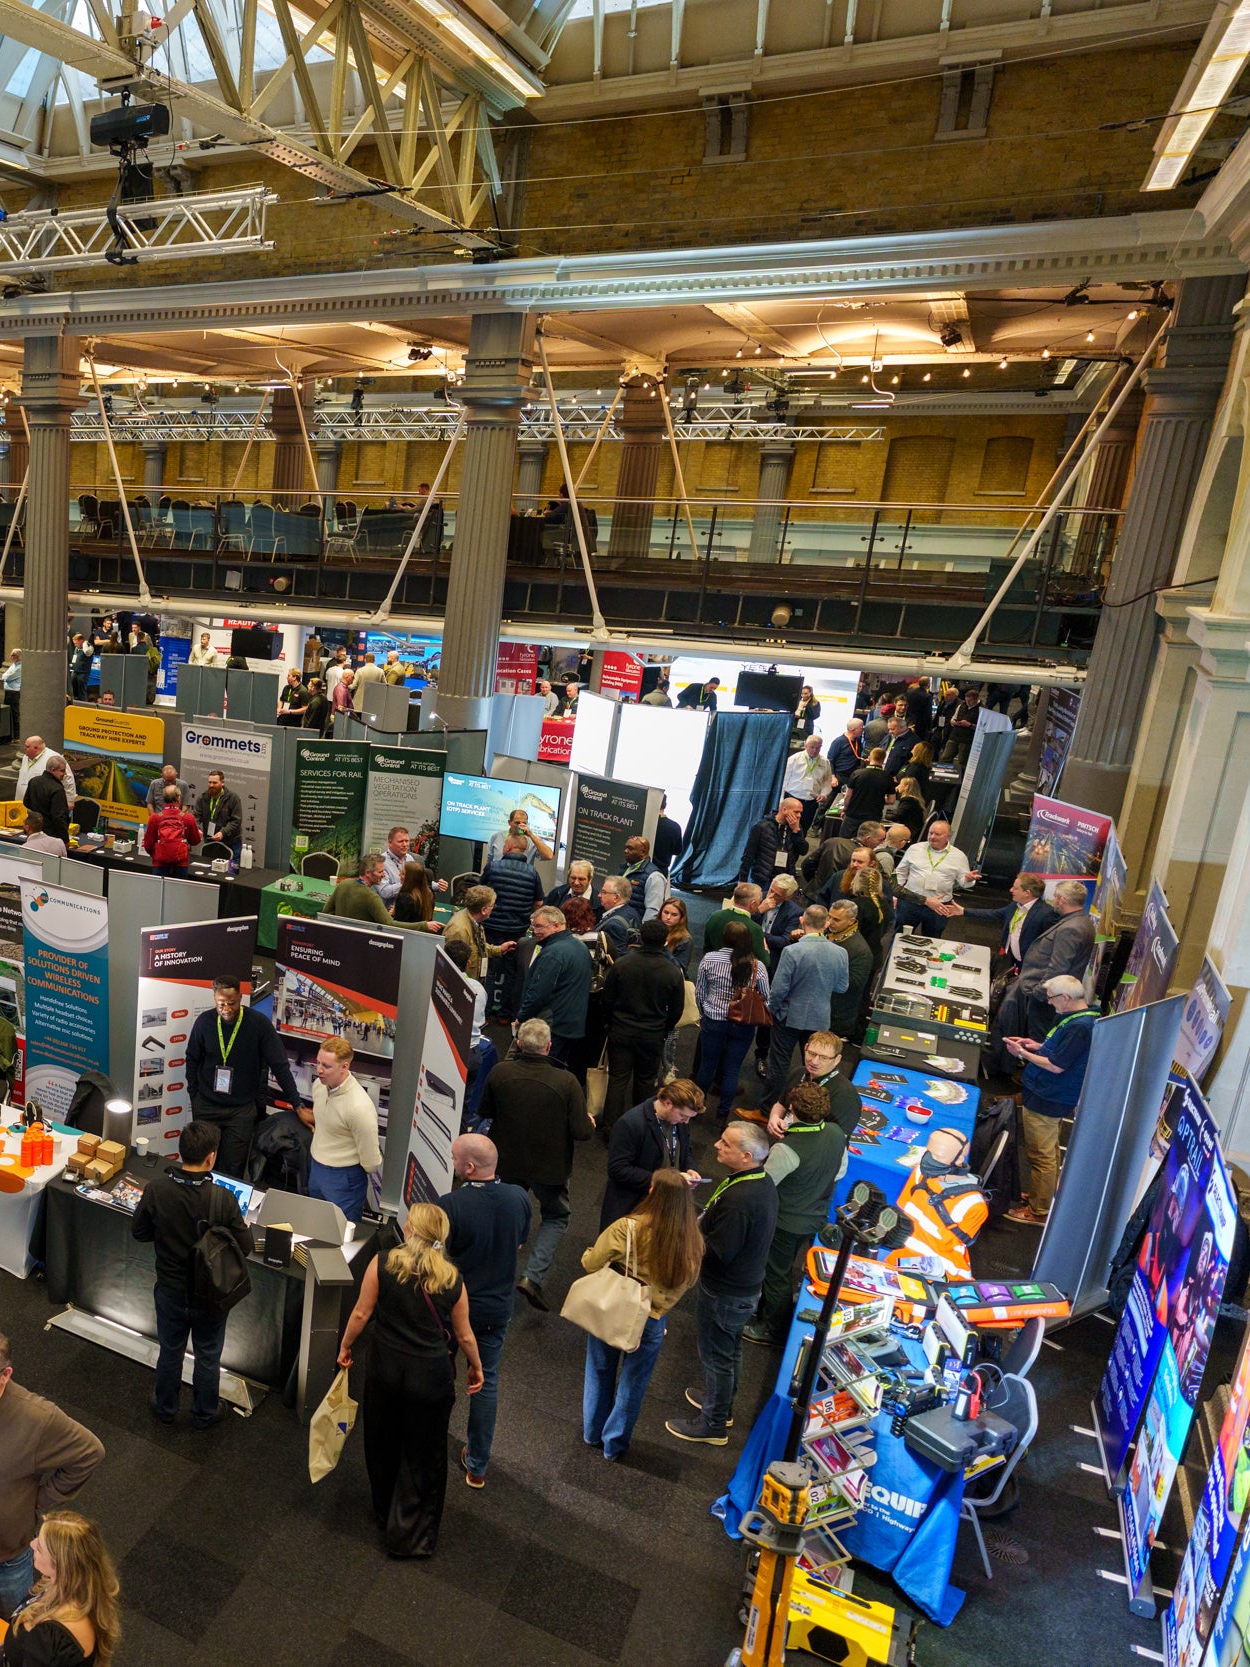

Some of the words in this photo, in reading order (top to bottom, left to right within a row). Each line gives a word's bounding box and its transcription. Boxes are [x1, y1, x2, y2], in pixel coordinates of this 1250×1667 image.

[95, 716, 130, 727] GroundGuards
[78, 725, 100, 734] GROUND
[101, 729, 134, 738] PROTECTION
[79, 731, 108, 740] TRACKWAY
[108, 735, 120, 743] HIRE
[122, 737, 146, 746] EXPERTS
[185, 730, 261, 753] Grommets
[539, 734, 573, 745] yrone
[538, 745, 571, 755] brication
[199, 753, 250, 764] www.grommets.co.uk
[332, 770, 347, 778] FOR
[373, 776, 420, 787] MECHANISED
[373, 783, 417, 793] VEGETATION
[588, 788, 607, 798] Ground
[373, 790, 418, 800] OPERATIONS
[584, 793, 603, 801] Control
[447, 806, 460, 814] (OTP)
[461, 808, 485, 817] SERVICES
[456, 801, 472, 809] TRACK
[473, 804, 490, 812] PLANT
[627, 802, 639, 811] BEST
[578, 806, 588, 815] ON
[590, 810, 613, 822] TRACK
[613, 815, 634, 827] PLANT
[1044, 811, 1070, 825] Trackwork
[1078, 821, 1099, 833] PINTSCH
[3, 906, 22, 917] Netwo
[50, 897, 101, 915] COMMUNICATIONS
[368, 938, 394, 950] designplan
[160, 951, 187, 959] HISTORY
[291, 945, 324, 957] ENSURING
[38, 949, 76, 967] PROVIDER
[78, 961, 88, 970] OF
[164, 956, 203, 966] INNOVATION
[290, 952, 311, 962] PEACE
[312, 955, 322, 963] OF
[322, 958, 341, 967] MIND
[27, 956, 70, 975] SOLUTIONS
[72, 969, 100, 984] DRIVEN
[44, 971, 81, 988] WIRELESS
[27, 976, 100, 1005] COMMUNICATIONS
[40, 995, 64, 1007] Handsfree
[65, 1002, 87, 1014] Solutions
[34, 1002, 54, 1013] Multiple
[56, 1008, 74, 1019] headset
[76, 1015, 93, 1025] choices
[32, 1010, 49, 1020] Variety
[56, 1017, 68, 1026] radio
[69, 1022, 96, 1035] accessories
[35, 1020, 61, 1032] Alternative
[72, 1031, 93, 1042] solutions
[1177, 1115, 1204, 1179] OPTRAIL
[810, 1491, 819, 1503] 02
[879, 1507, 891, 1515] the
